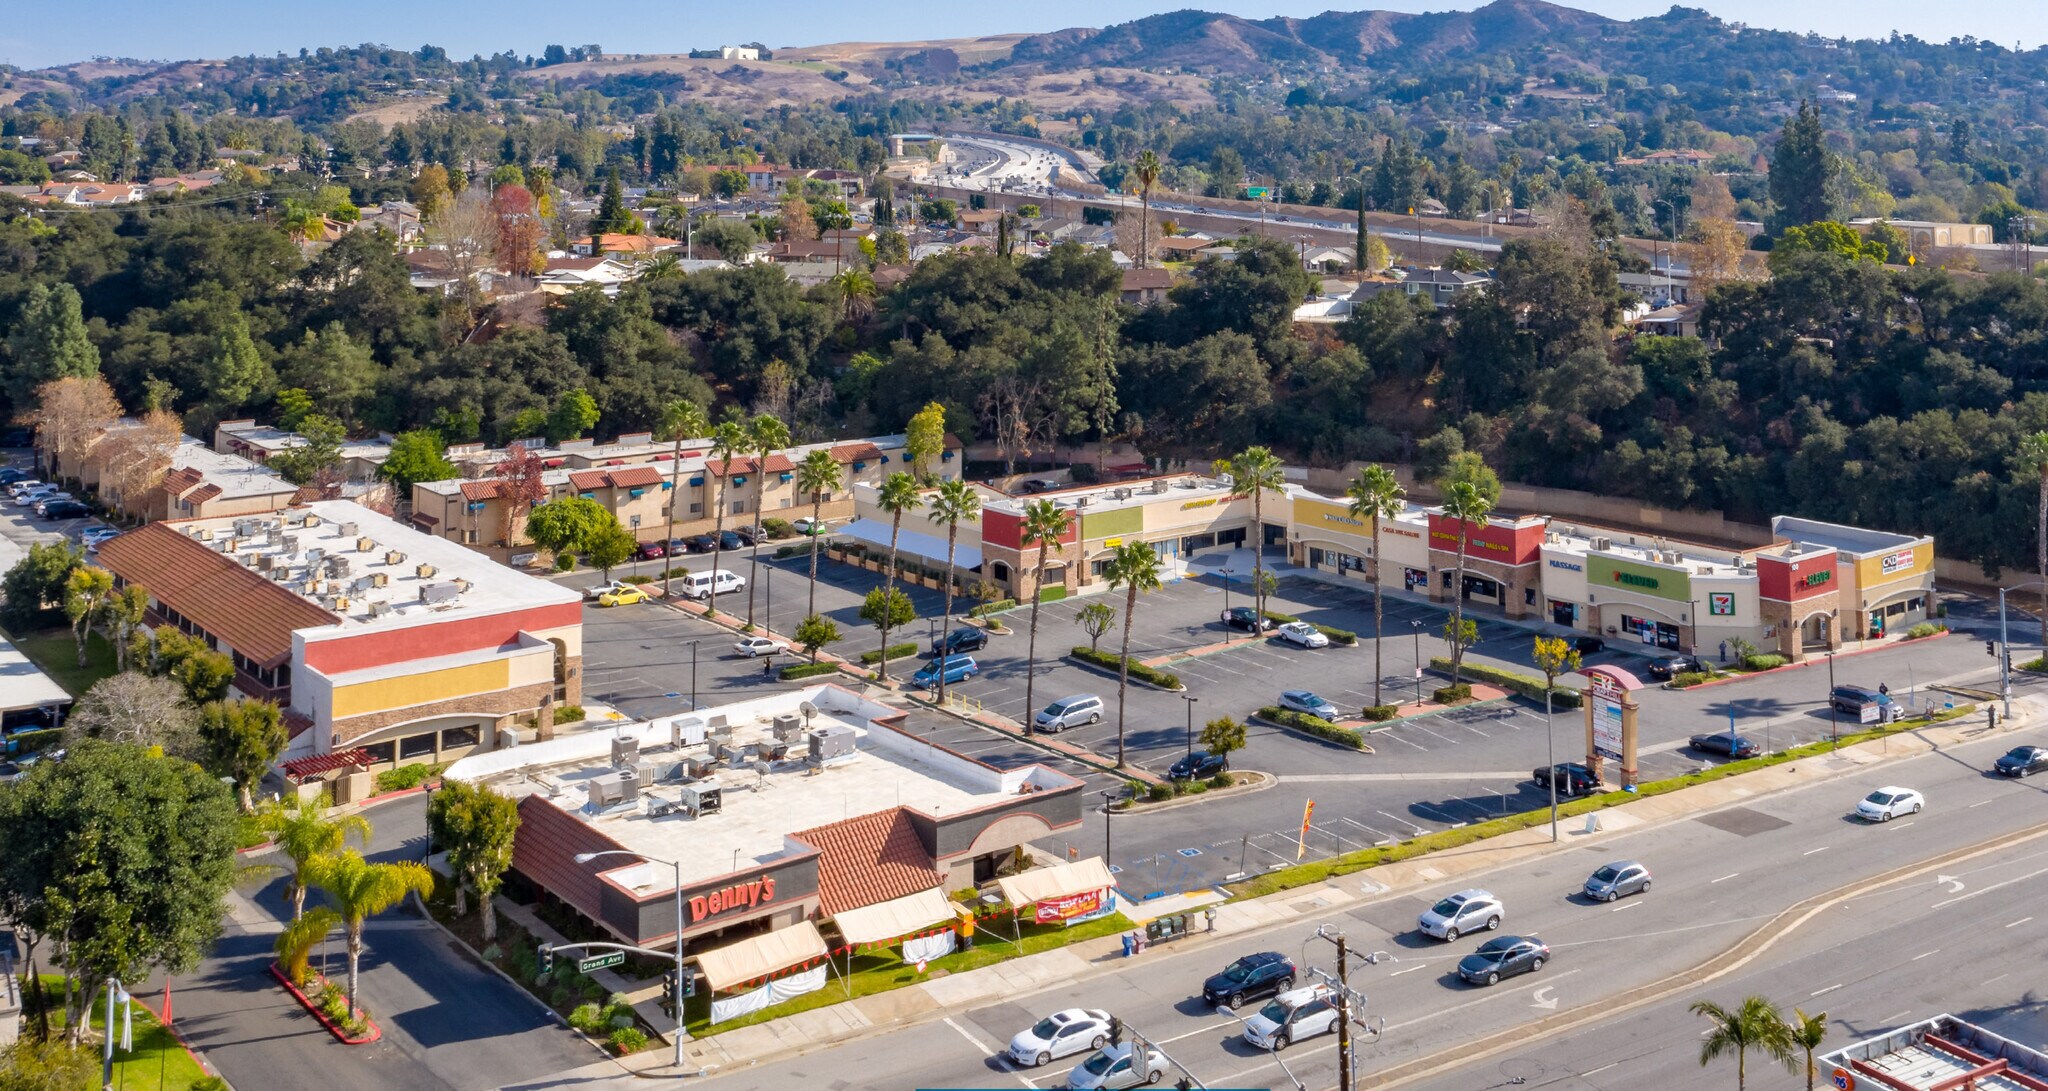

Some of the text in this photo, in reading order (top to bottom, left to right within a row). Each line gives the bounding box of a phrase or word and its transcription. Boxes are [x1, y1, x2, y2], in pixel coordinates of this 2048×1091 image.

[1549, 560, 1582, 572] MASSAGE
[1791, 563, 1799, 571] 100
[1883, 555, 1897, 567] CKD
[689, 875, 776, 922] Denny's
[582, 956, 622, 970] Grand Ave
[1835, 1076, 1847, 1089] 76
